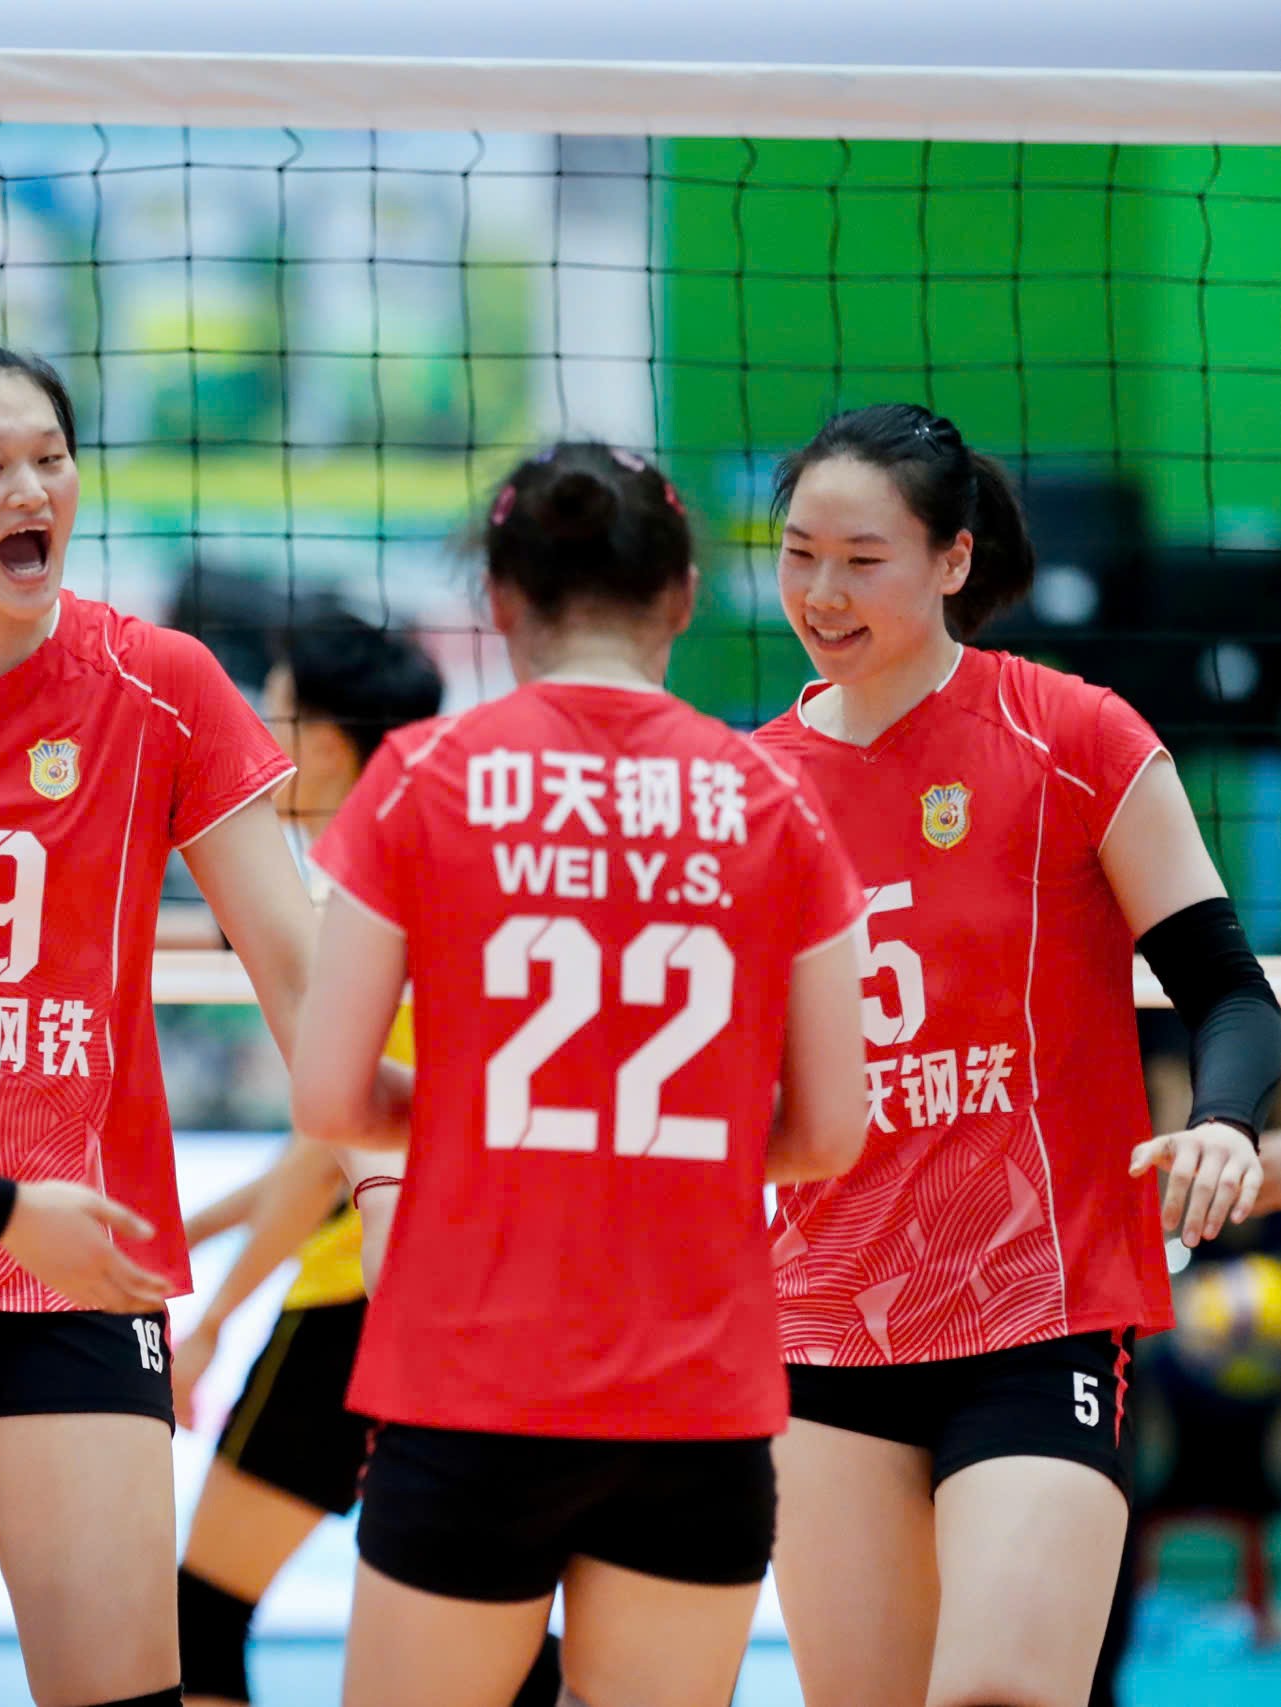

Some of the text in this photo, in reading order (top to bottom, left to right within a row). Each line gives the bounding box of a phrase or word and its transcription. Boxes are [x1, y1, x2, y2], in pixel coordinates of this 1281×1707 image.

[467, 748, 747, 845] 中天钢铁
[493, 843, 733, 909] WEI Y.S.
[855, 880, 926, 1047] 5
[484, 915, 735, 1161] 22
[132, 1318, 163, 1374] 19
[1073, 1371, 1100, 1427] 5
